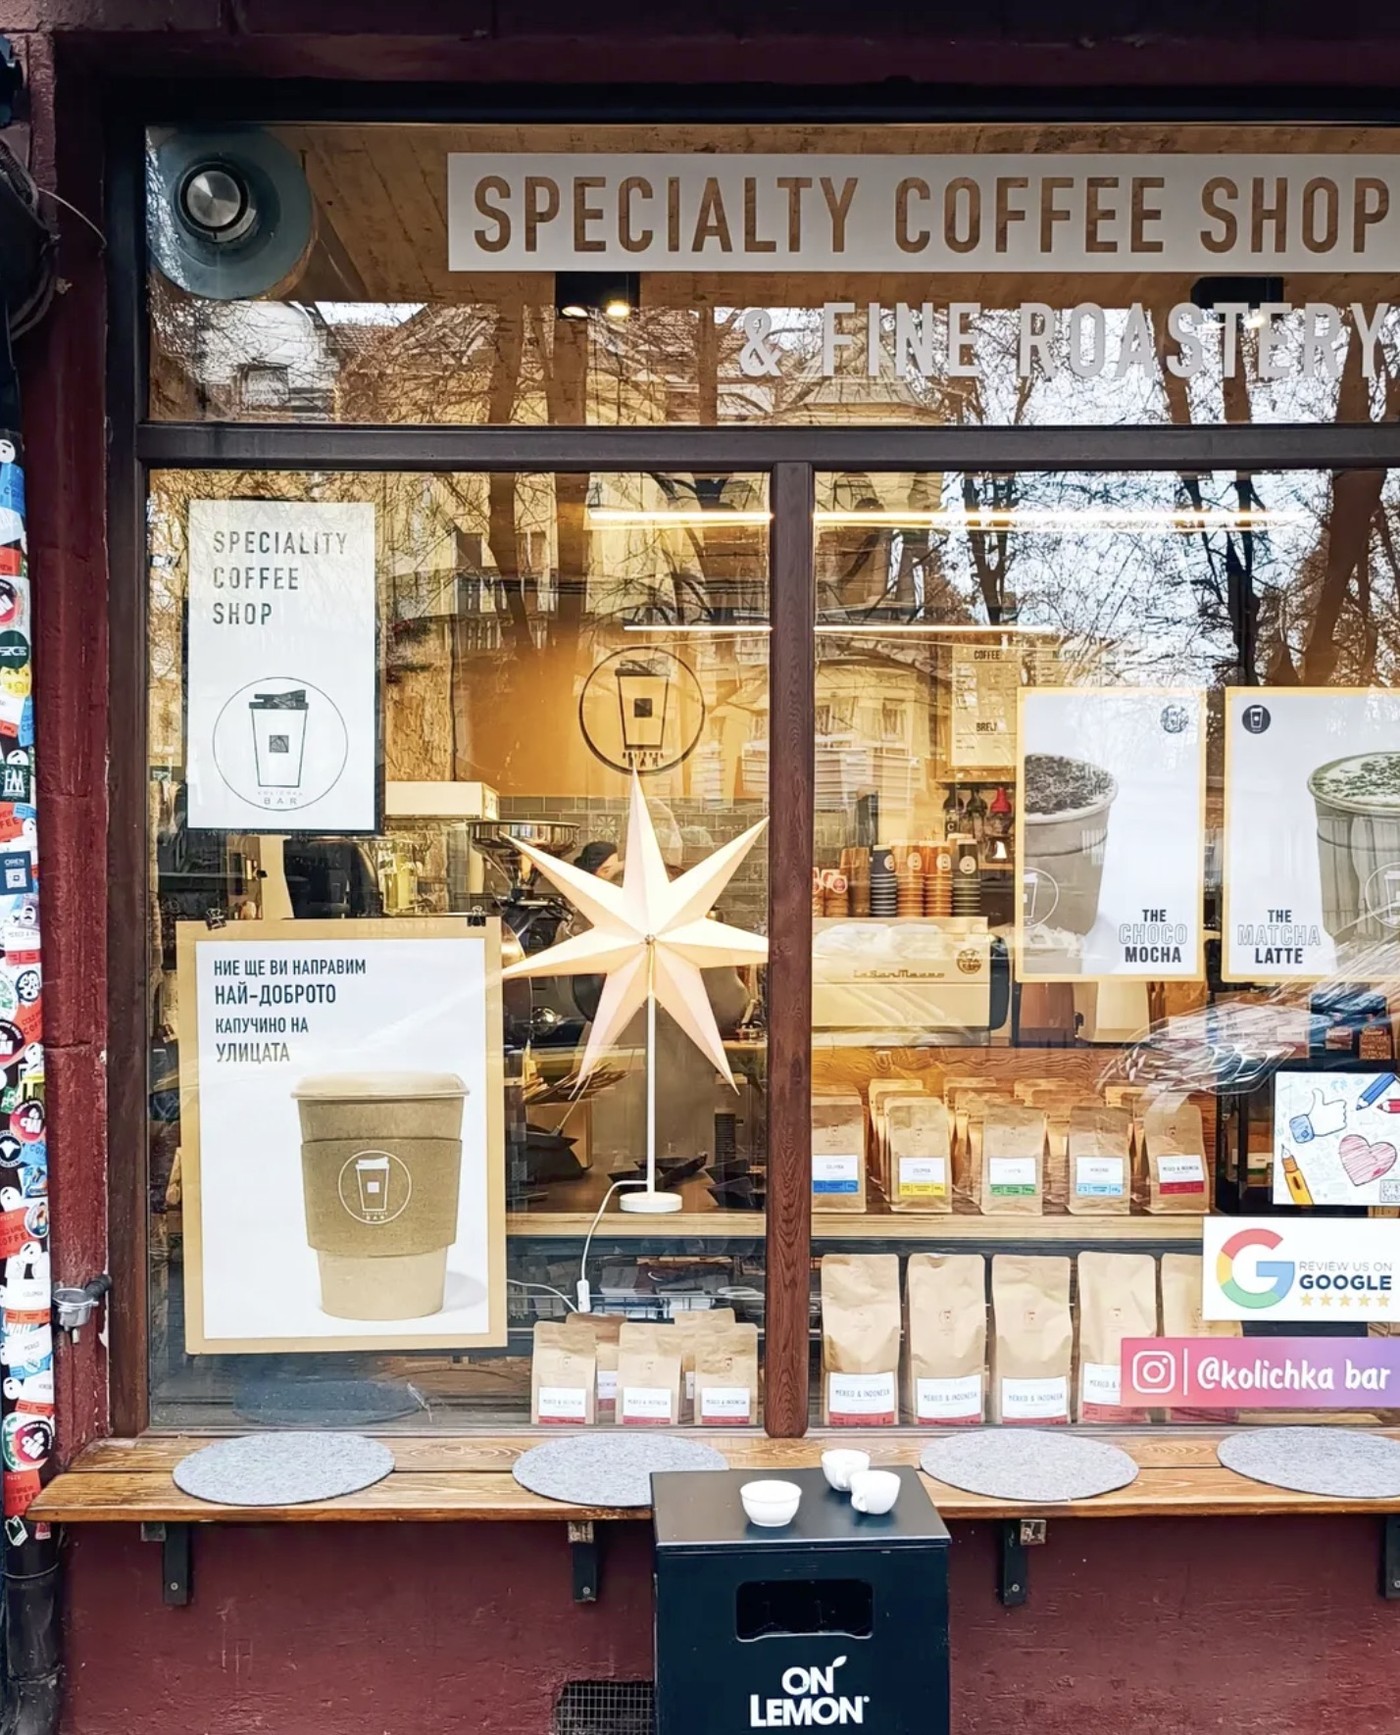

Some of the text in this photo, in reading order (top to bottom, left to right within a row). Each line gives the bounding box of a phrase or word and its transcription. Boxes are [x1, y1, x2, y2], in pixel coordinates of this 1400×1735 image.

[474, 175, 1389, 253] SPECIALTY COFFEE SHOP
[740, 302, 1390, 378] & FINE ROASTERY
[213, 531, 347, 554] SPECIALITY
[213, 567, 298, 589] COFFEE
[213, 602, 272, 625] SHOP
[974, 650, 1000, 660] COFFEE
[1142, 909, 1167, 922] THE
[1267, 909, 1292, 923] THE
[1118, 923, 1188, 945] CHOCO
[1237, 924, 1321, 946] MATCHA
[1125, 946, 1181, 963] MOCHA
[1255, 948, 1303, 964] LATTE
[214, 959, 366, 977] НИЕ ЩЕ ВИ НАПРАВИМ
[215, 981, 336, 1007] НАЙ-ДОБРОТО
[216, 1017, 309, 1033] КАПУЧИНО НА
[216, 1042, 290, 1064] УЛИЦАТА
[1299, 1261, 1392, 1271] REVIEW US ON
[1299, 1274, 1392, 1290] GOOGLE
[1197, 1356, 1391, 1390] @kolichka bar
[781, 1666, 835, 1695] ON
[750, 1694, 864, 1727] LEMON
